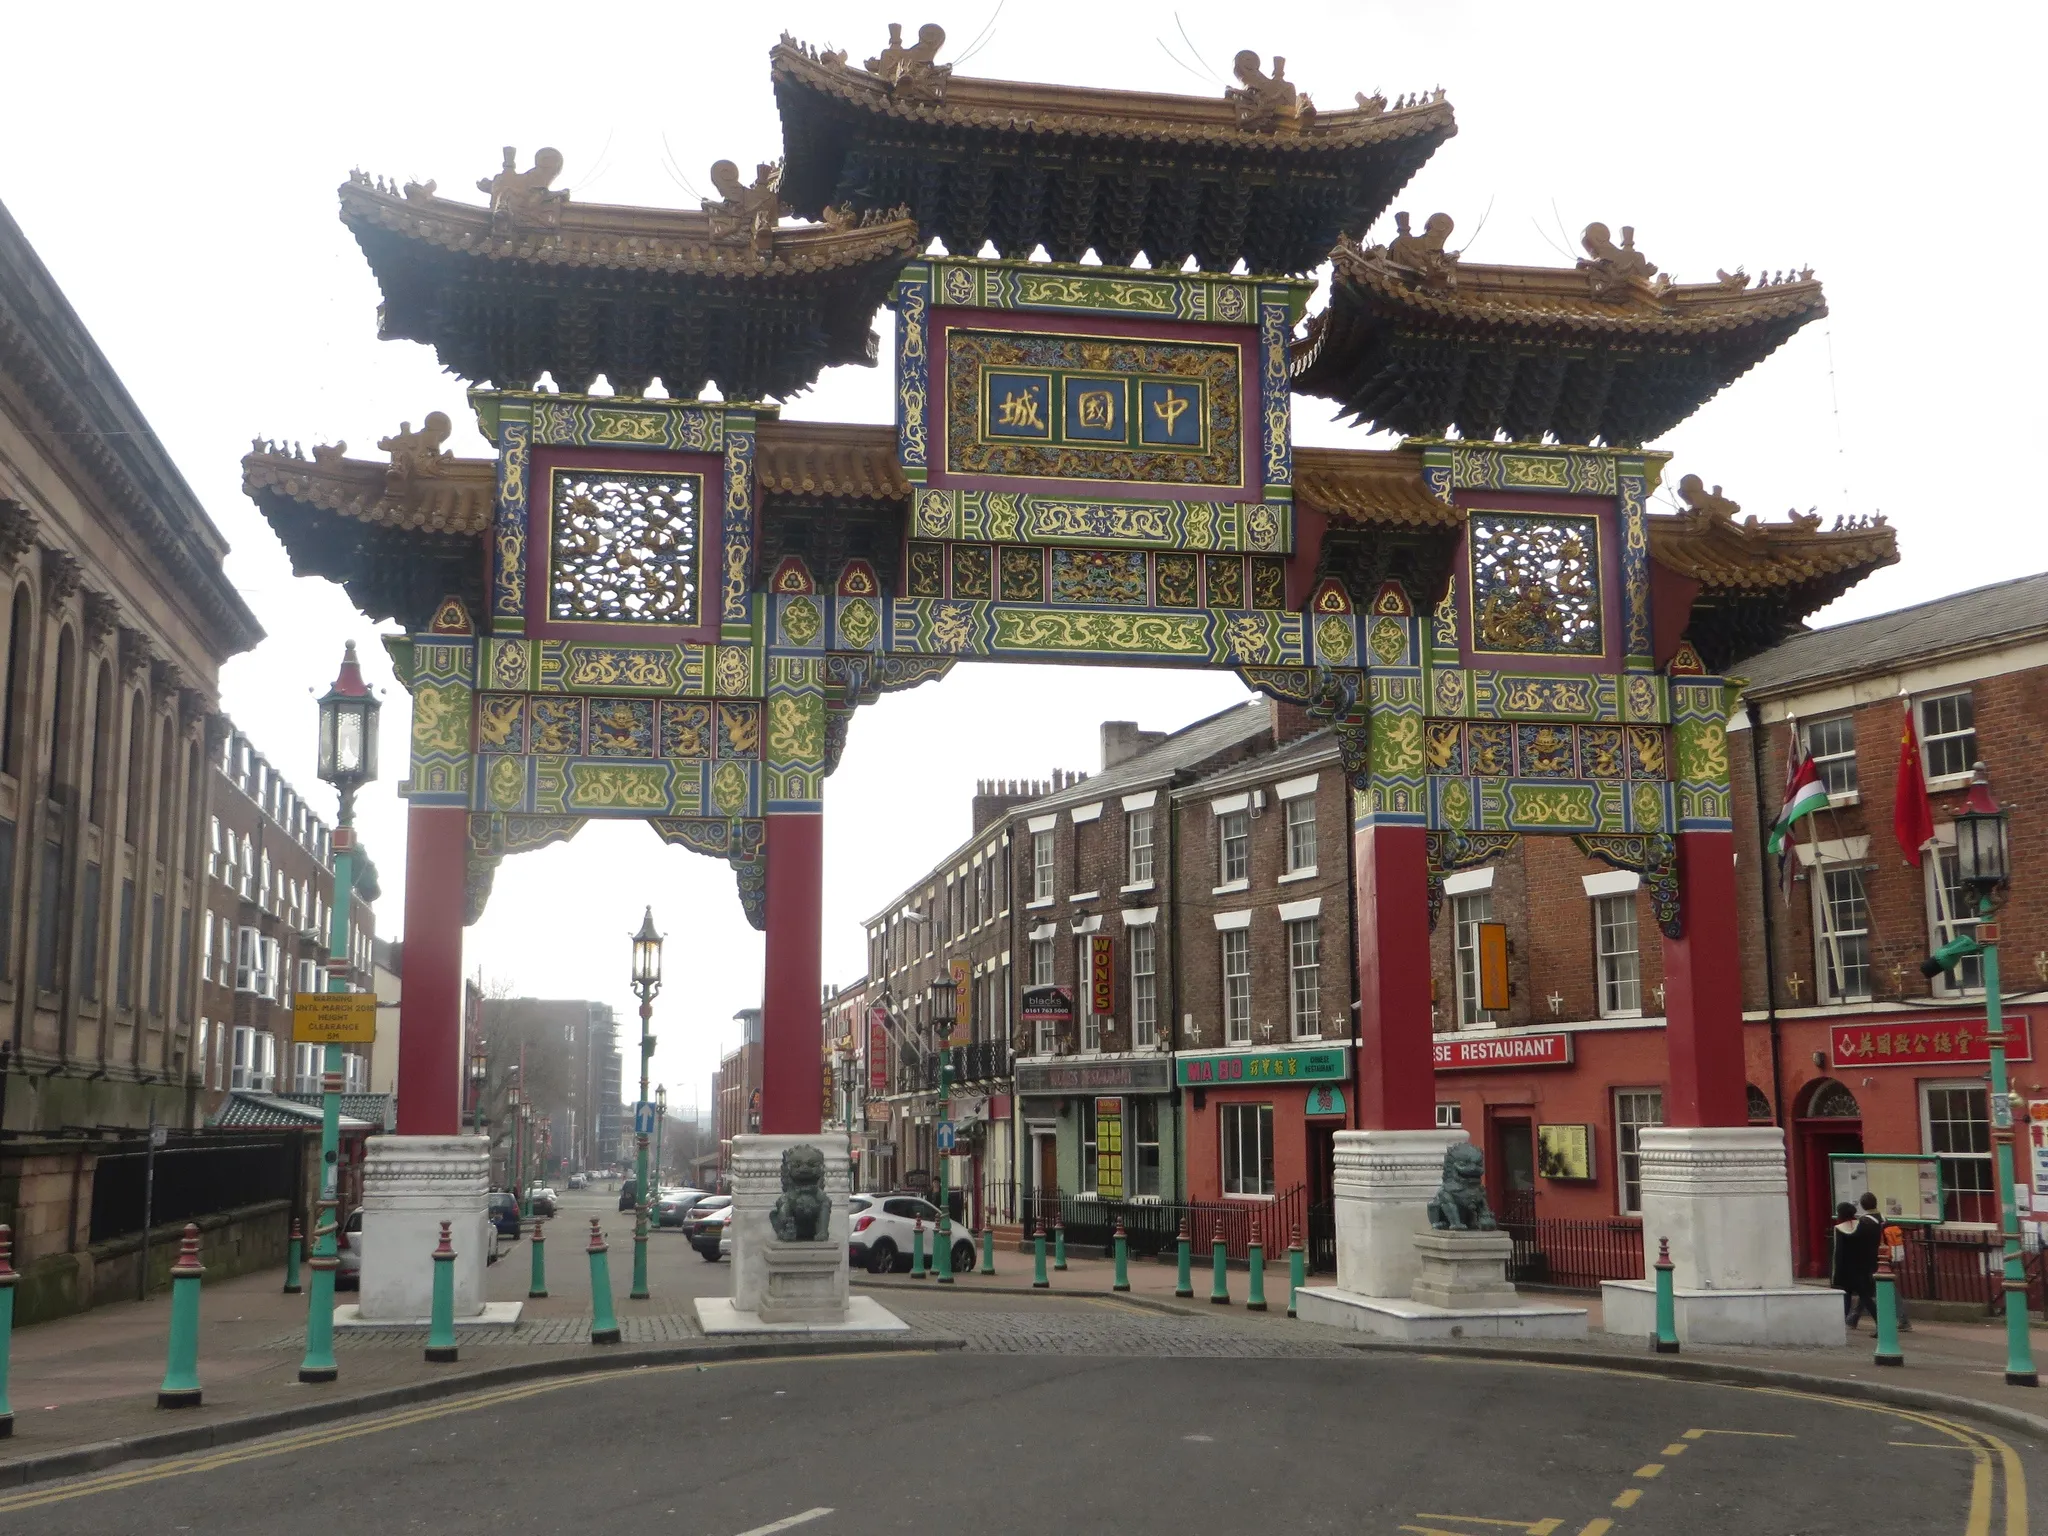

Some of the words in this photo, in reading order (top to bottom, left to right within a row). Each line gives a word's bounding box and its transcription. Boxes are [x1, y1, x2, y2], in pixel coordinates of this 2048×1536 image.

[313, 995, 353, 1003] WARNING
[1029, 991, 1062, 1005] blacks
[296, 1004, 319, 1012] UNTIL
[322, 1004, 353, 1012] MARCH
[308, 1023, 360, 1031] CLEARANCE
[1460, 1038, 1555, 1061] RESTAURANT
[1187, 1060, 1213, 1082] MA
[1218, 1058, 1243, 1081] BO
[1305, 1064, 1335, 1073] RESTAURANT
